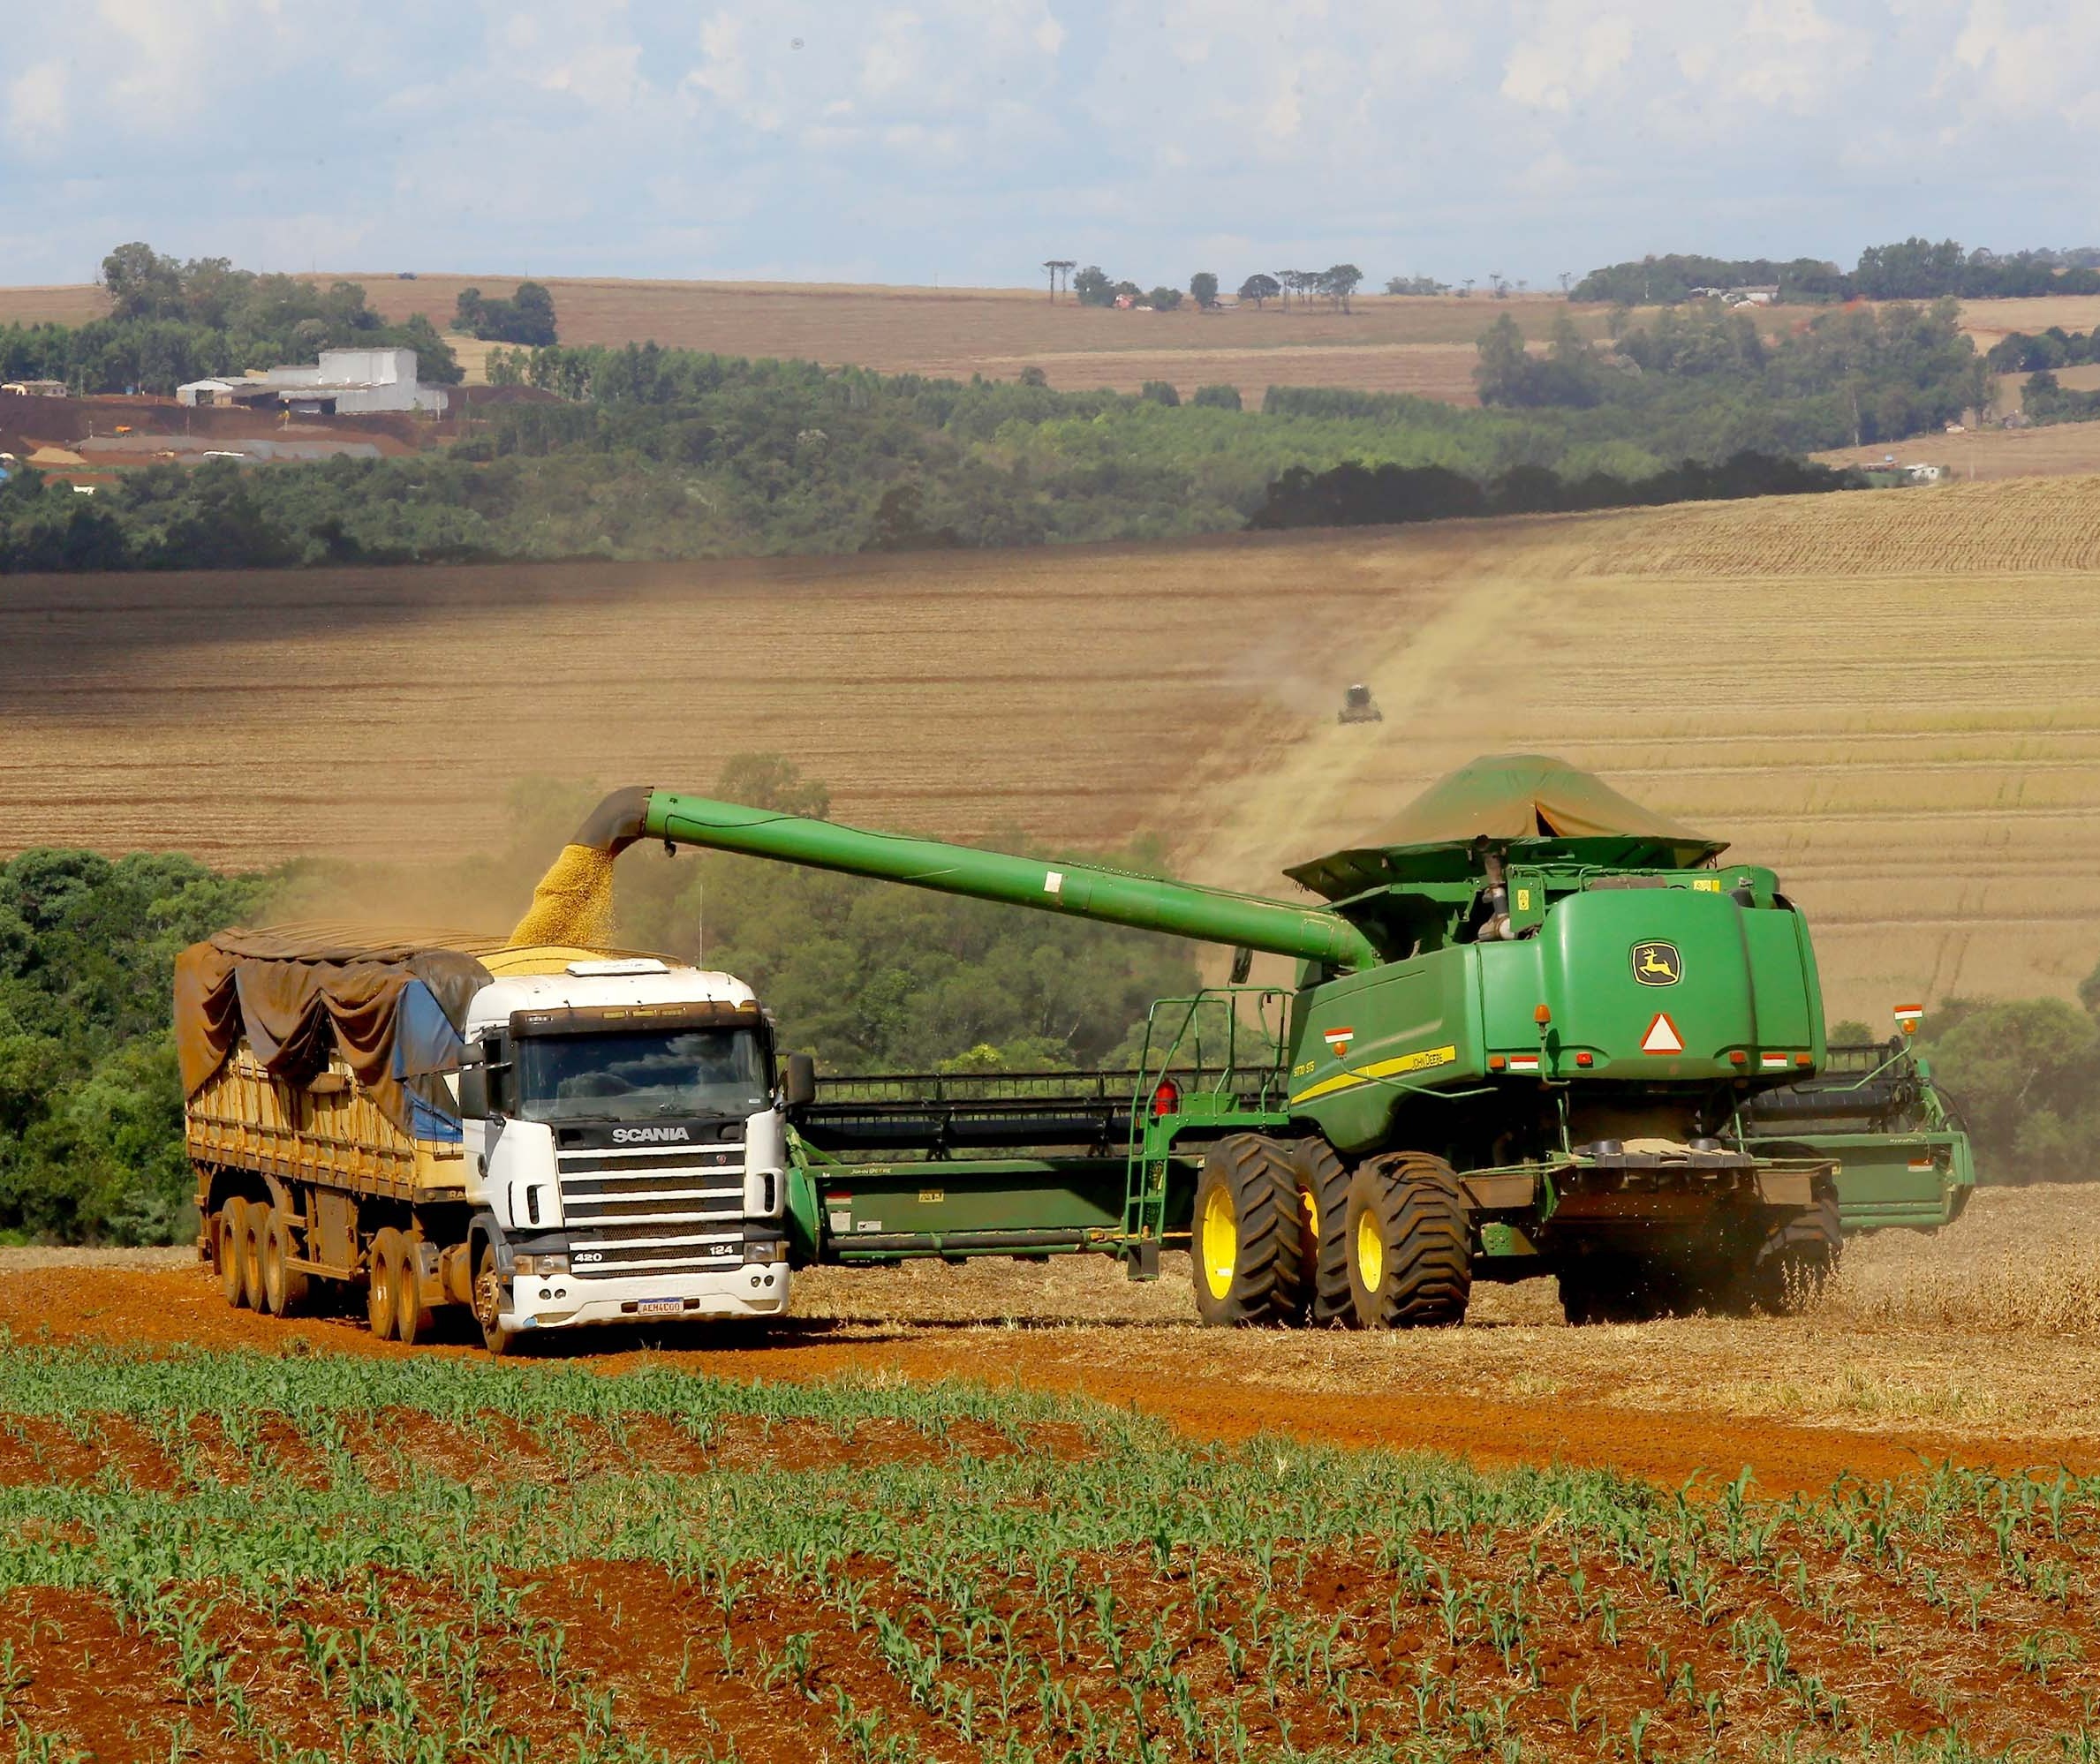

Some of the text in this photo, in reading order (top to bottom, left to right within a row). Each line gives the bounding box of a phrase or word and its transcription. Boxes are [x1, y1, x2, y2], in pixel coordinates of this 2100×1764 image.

[1425, 1053, 1444, 1066] DEERE
[612, 1127, 690, 1143] SCANIA
[709, 1245, 734, 1255] 124
[574, 1252, 603, 1263] 420
